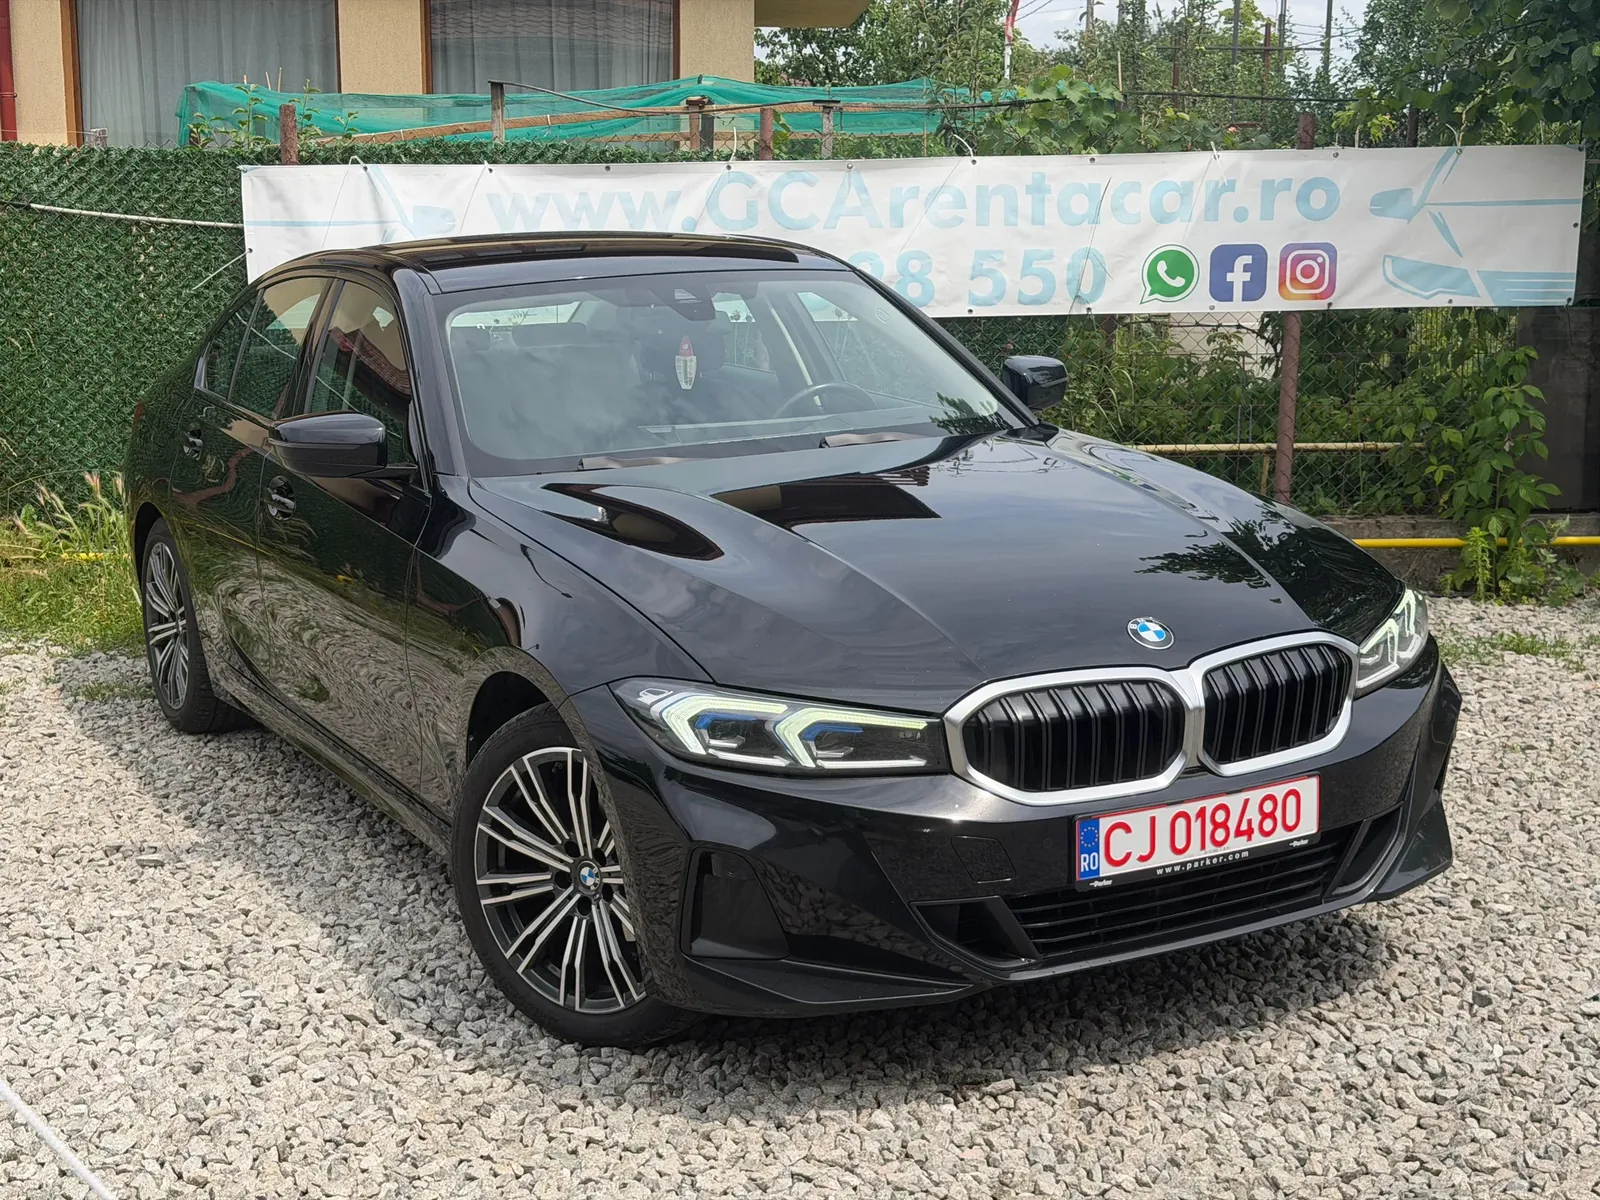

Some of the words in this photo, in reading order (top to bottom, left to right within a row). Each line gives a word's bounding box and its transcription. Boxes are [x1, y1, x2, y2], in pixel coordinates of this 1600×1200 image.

[486, 170, 1341, 233] www.GCArentacar.ro
[967, 246, 1108, 307] 550
[1103, 815, 1157, 868] CJ
[1169, 788, 1301, 855] 018480
[1080, 851, 1099, 873] RO
[1156, 851, 1249, 875] www.parker.com
